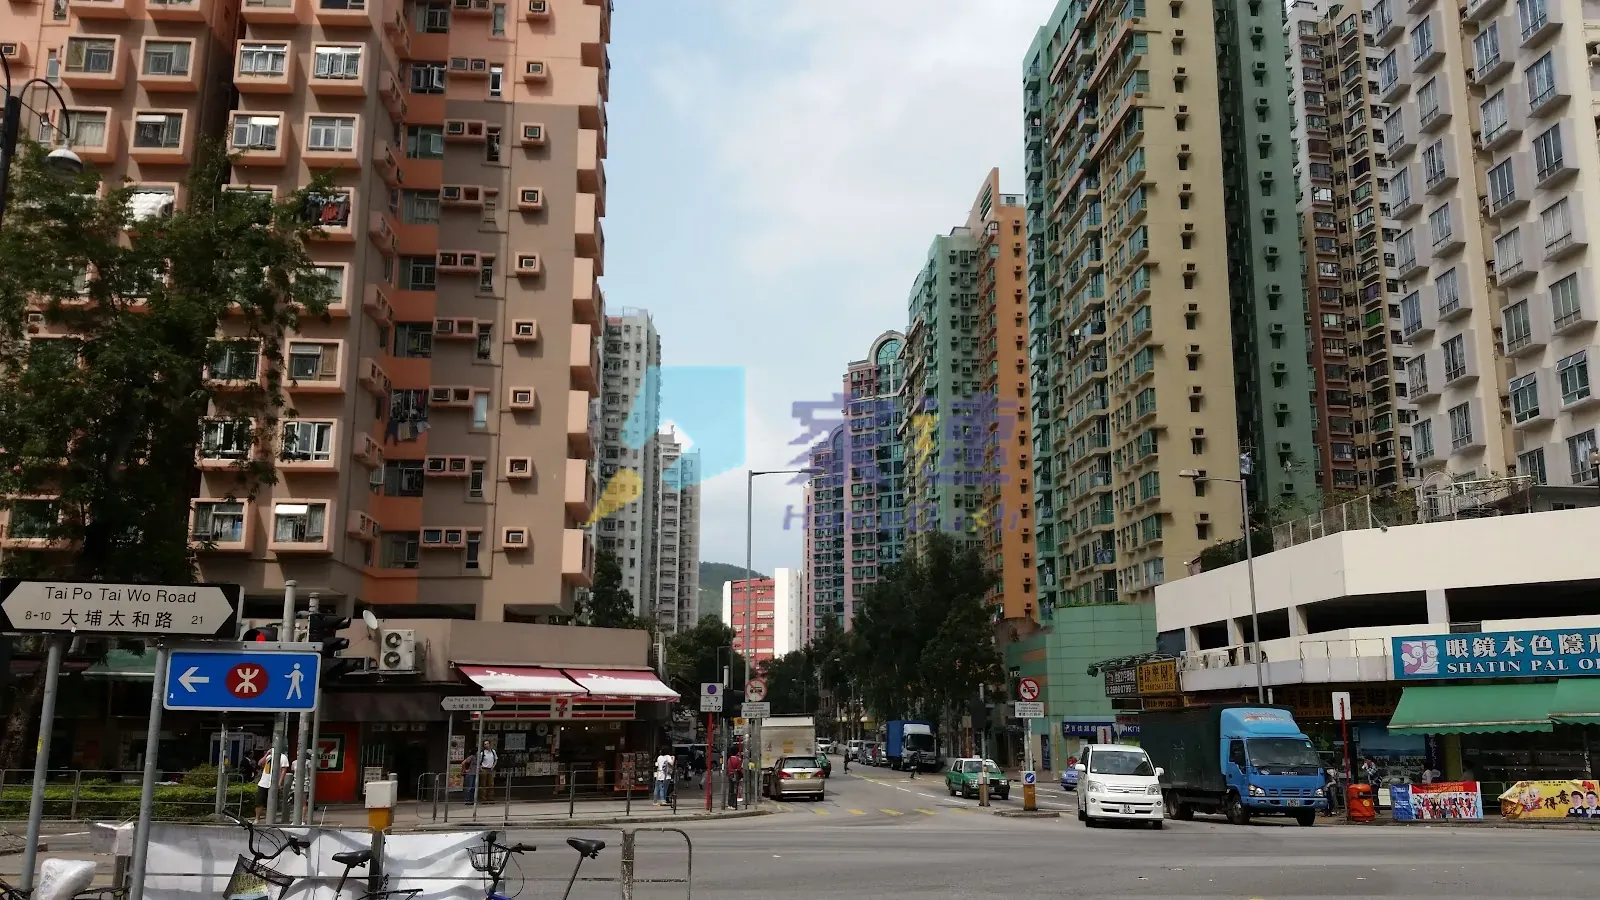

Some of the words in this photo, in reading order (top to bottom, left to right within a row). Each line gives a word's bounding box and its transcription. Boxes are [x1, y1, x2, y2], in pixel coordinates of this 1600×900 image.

[45, 586, 68, 600] Tai
[72, 587, 92, 600] Po
[99, 588, 121, 601] Tai
[127, 589, 151, 602] Wo
[156, 590, 197, 603] Road
[25, 610, 51, 621] 8-10
[61, 608, 173, 629] 大埔太和路
[191, 615, 204, 625] 21
[1447, 661, 1521, 674] SHATIN
[1531, 659, 1568, 671] PAL
[317, 741, 337, 769] 7
